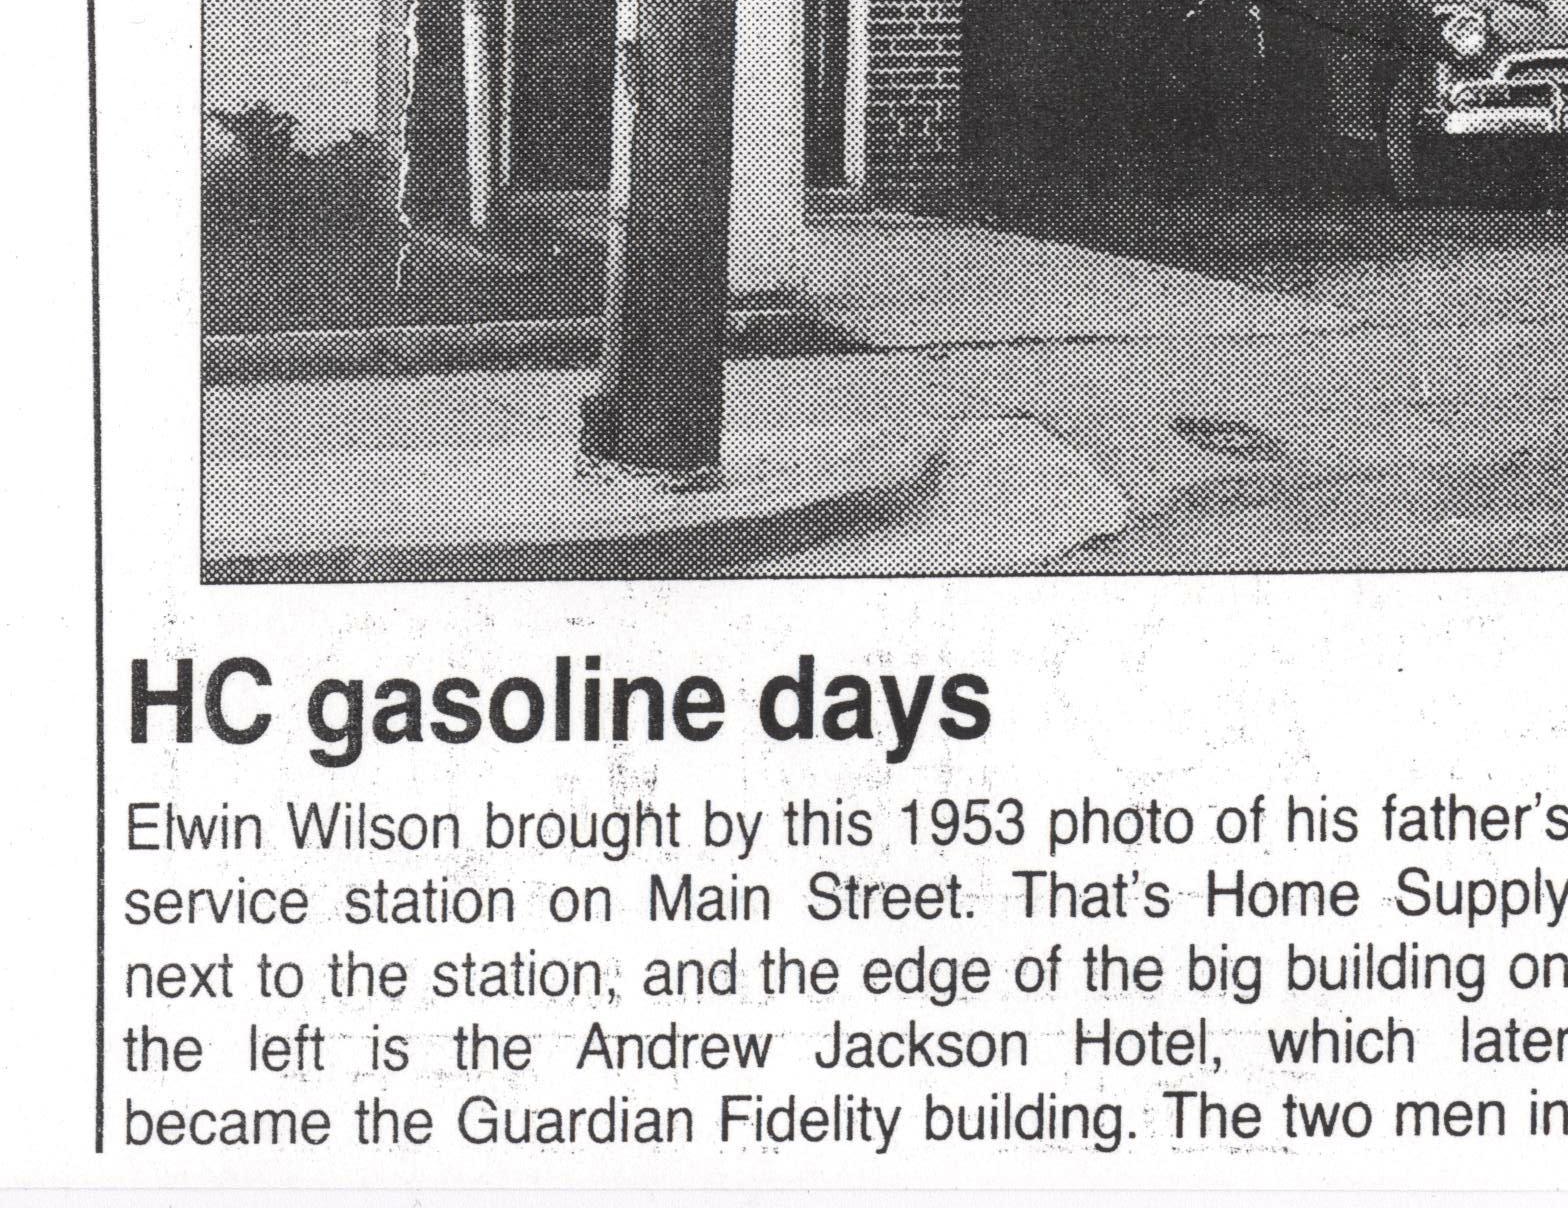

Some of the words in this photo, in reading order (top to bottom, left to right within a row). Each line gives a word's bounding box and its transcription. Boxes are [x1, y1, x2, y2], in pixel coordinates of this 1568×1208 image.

[131, 657, 272, 745] HC
[307, 655, 725, 768] gasoline
[759, 654, 991, 764] days
[128, 802, 262, 850] Elwin
[287, 801, 459, 851] Wilson
[486, 799, 681, 862] brought
[705, 799, 763, 860] by
[784, 798, 873, 847] this
[901, 797, 1025, 846] 1953
[1050, 796, 1194, 857] photo
[1216, 794, 1266, 844] of
[1288, 794, 1358, 843] his
[125, 888, 308, 925] service
[345, 879, 514, 925] station
[549, 886, 611, 923] on
[650, 873, 770, 922] Main
[808, 871, 974, 921] Street.
[1012, 870, 1170, 919] That's
[1207, 869, 1360, 918] Home
[126, 953, 233, 999] next
[257, 953, 303, 998] to
[328, 953, 407, 998] the
[432, 951, 615, 1004] station,
[643, 947, 737, 996] and
[761, 947, 839, 995] the
[863, 945, 991, 1007] edge
[1015, 943, 1062, 993] of
[1083, 944, 1164, 992] the
[1189, 943, 1261, 1005] big
[1288, 942, 1485, 1003] building
[123, 1024, 203, 1072] the
[250, 1023, 325, 1072] left
[372, 1035, 409, 1072] is
[453, 1023, 532, 1071] the
[576, 1021, 773, 1070] Andrew
[815, 1019, 1027, 1069] Jackson
[1075, 1017, 1221, 1074] Hotel,
[1268, 1016, 1414, 1064] which
[126, 1098, 331, 1146] became
[355, 1097, 433, 1145] the
[458, 1095, 693, 1145] Guardian
[721, 1094, 902, 1155] Fidelity
[926, 1092, 1136, 1153] building.
[1162, 1090, 1261, 1139] The
[1282, 1093, 1372, 1138] two
[1396, 1100, 1505, 1137] men
